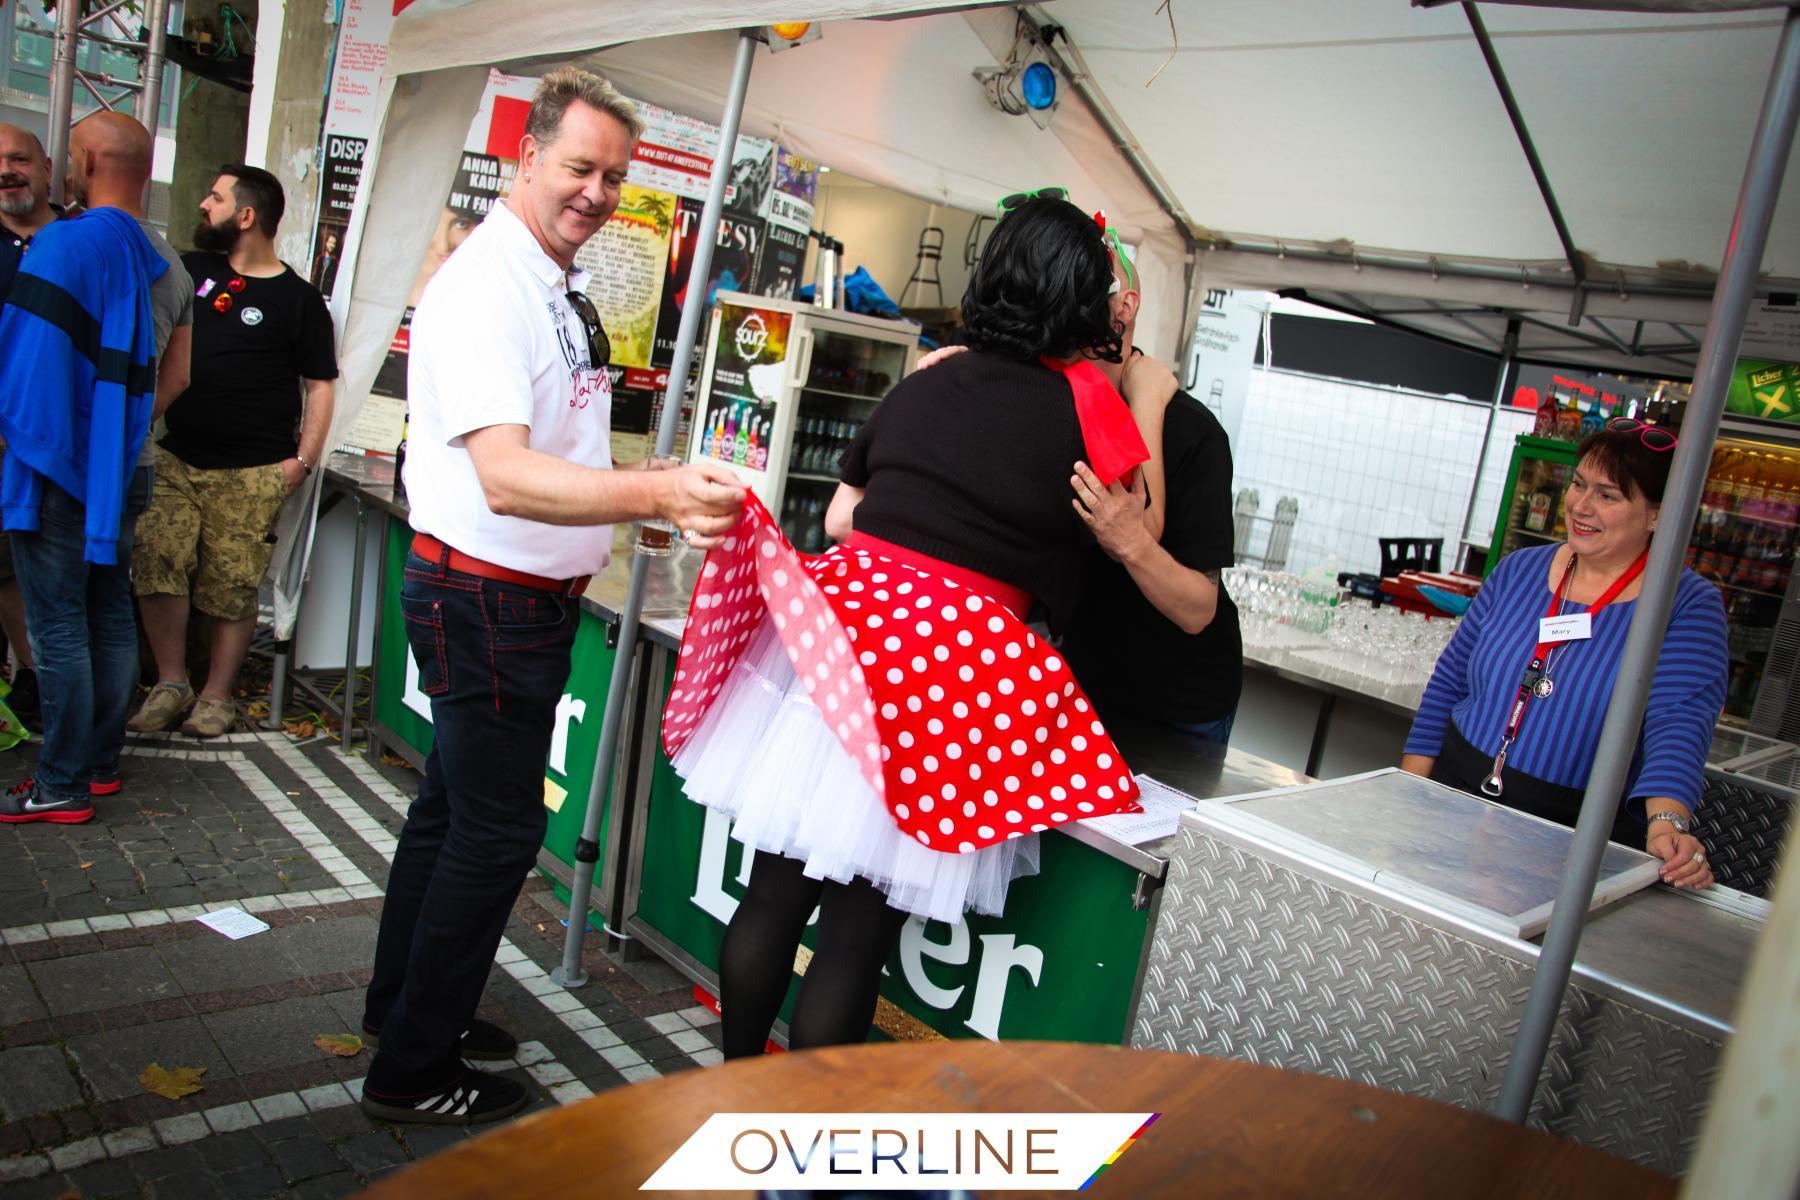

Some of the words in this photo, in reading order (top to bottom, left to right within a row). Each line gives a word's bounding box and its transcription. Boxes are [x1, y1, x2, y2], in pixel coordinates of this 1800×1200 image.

[330, 138, 366, 160] DISP
[462, 156, 498, 176] ANNA
[469, 173, 513, 192] KAUFM
[450, 192, 471, 209] MY
[472, 195, 493, 211] FAI
